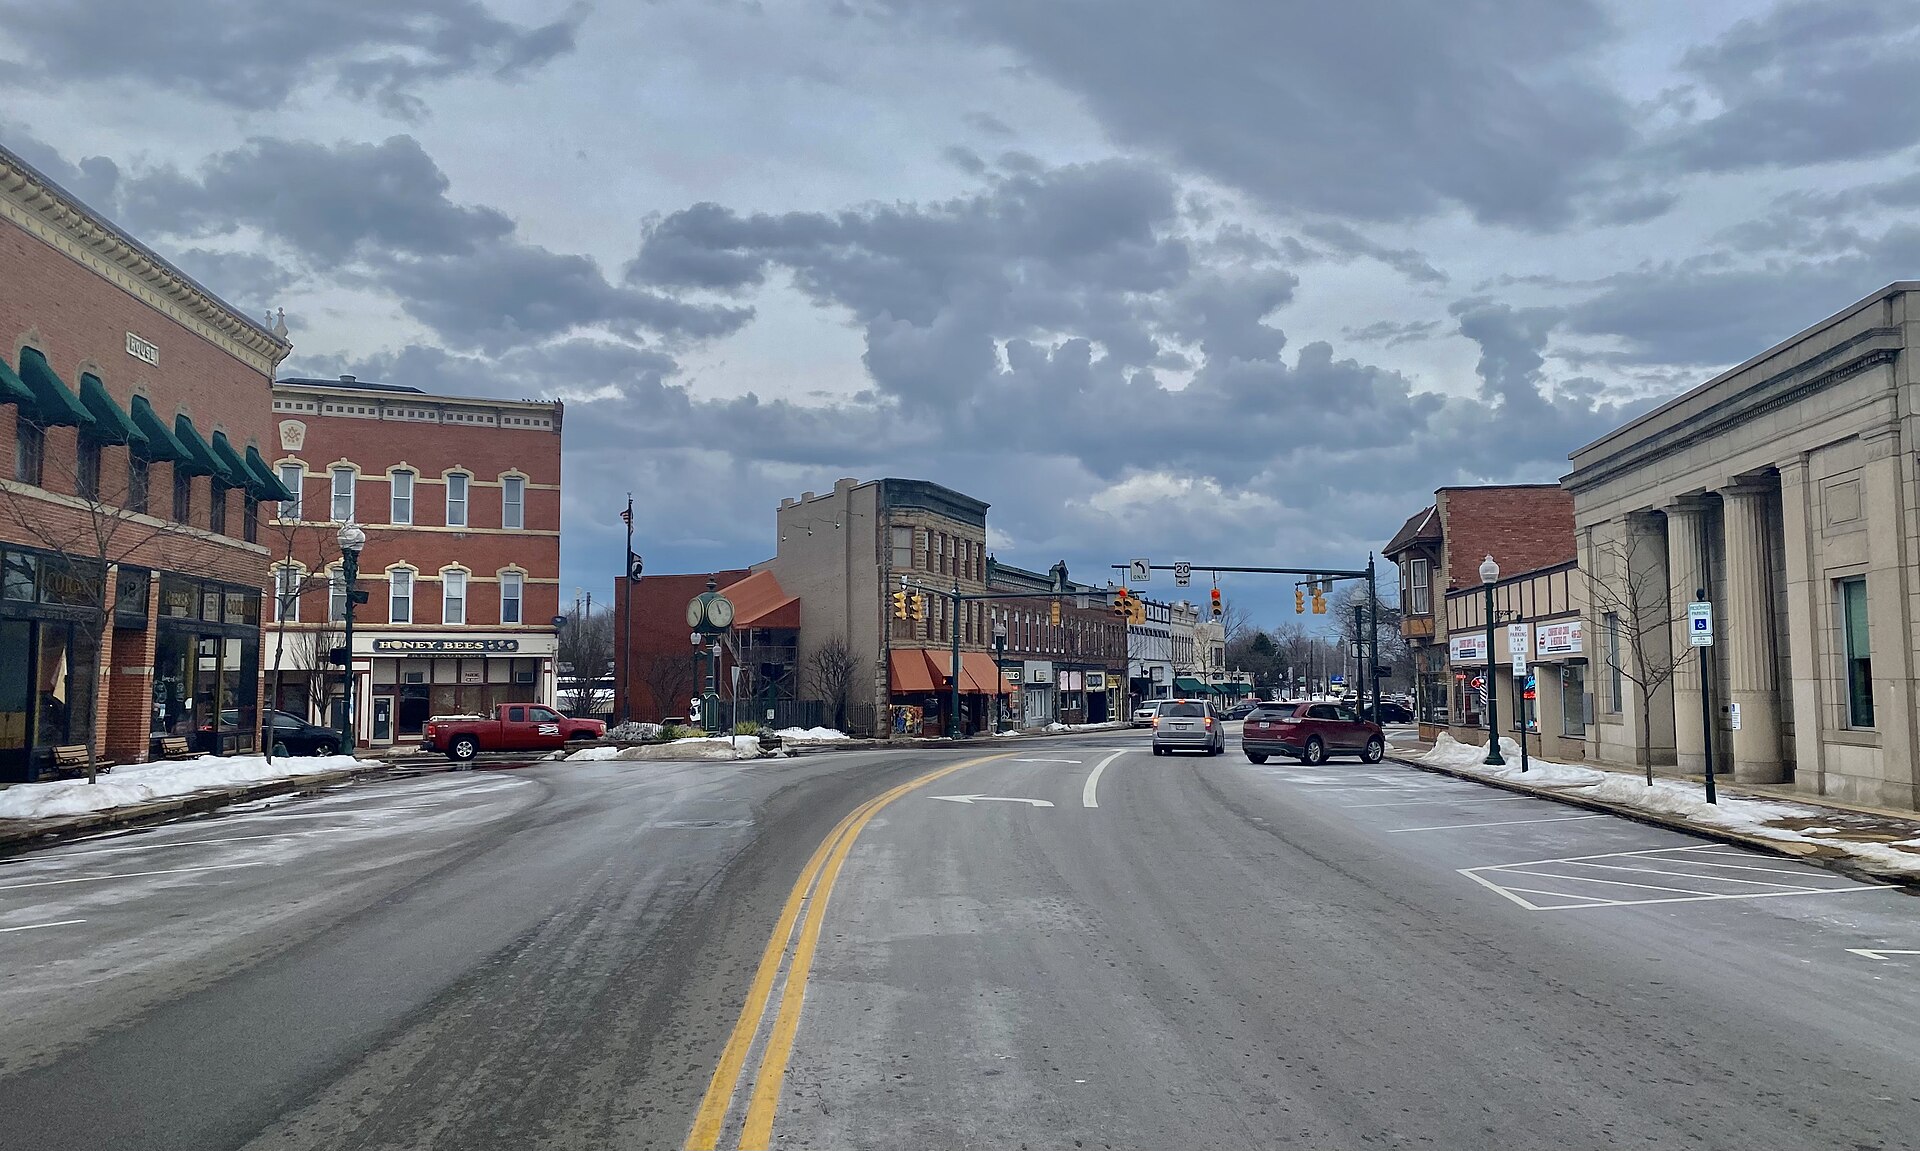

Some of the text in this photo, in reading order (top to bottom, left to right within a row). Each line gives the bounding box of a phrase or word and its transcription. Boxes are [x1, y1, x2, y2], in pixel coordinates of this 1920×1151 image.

[130, 338, 156, 361] HOUSE
[1176, 565, 1189, 574] 20
[379, 640, 484, 650] HONEY BEES
